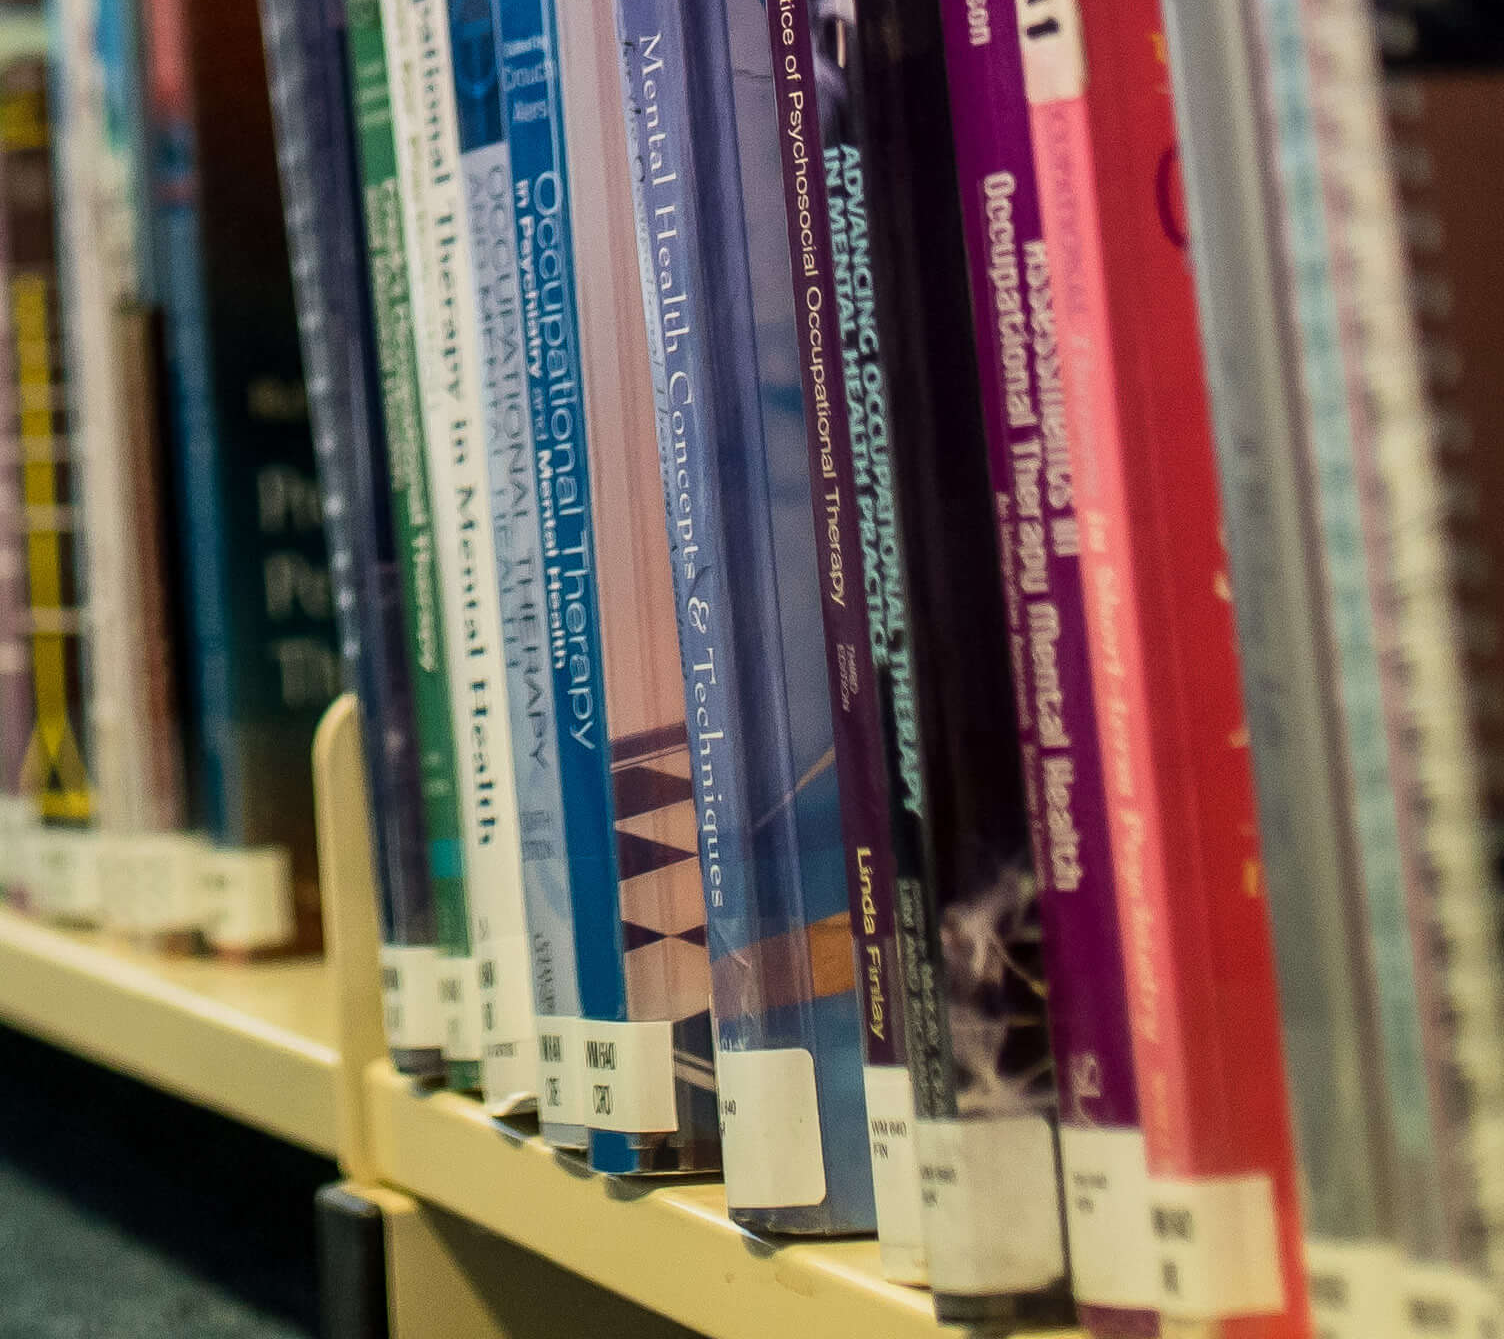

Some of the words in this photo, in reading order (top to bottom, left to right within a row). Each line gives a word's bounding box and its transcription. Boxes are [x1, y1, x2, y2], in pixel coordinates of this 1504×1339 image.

[632, 31, 677, 189] Mental
[783, 53, 802, 83] of
[781, 90, 819, 278] Psychosocial
[820, 146, 844, 191] IN
[649, 202, 692, 354] Health
[822, 194, 861, 340] MENTAL
[978, 170, 1042, 428] Occupational
[799, 284, 839, 480] Occupational
[835, 140, 880, 355] ADVANCING
[858, 359, 908, 641] OCCUPATIONAL
[528, 168, 588, 518] Occupational
[558, 530, 603, 755] Therapy
[662, 368, 706, 580] Concepts
[1004, 440, 1055, 596] Therapy
[685, 594, 710, 637] &
[819, 486, 851, 608] Therapy
[1023, 601, 1072, 750] Mental
[686, 649, 730, 910] Techniques
[1041, 755, 1087, 892] Health
[852, 845, 881, 937] Linda
[861, 941, 889, 1041] Finlay
